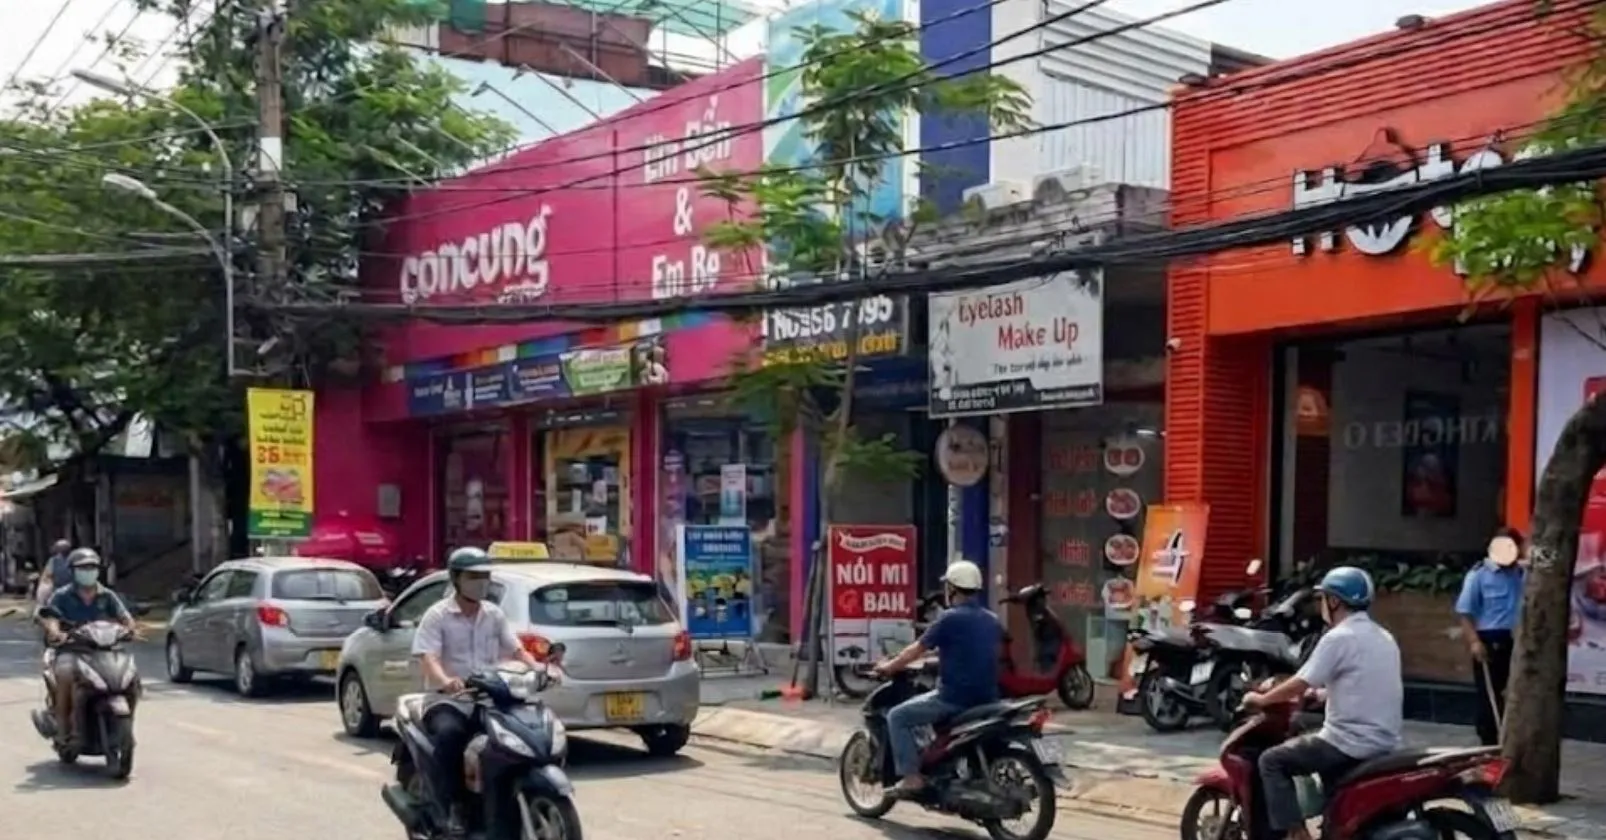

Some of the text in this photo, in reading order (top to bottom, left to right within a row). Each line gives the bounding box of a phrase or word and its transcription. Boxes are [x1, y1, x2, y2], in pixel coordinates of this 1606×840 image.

[673, 187, 693, 236] &
[652, 255, 685, 299] Em
[958, 292, 1025, 327] Eyelash
[998, 318, 1079, 351] Make Up
[880, 564, 908, 585] MI
